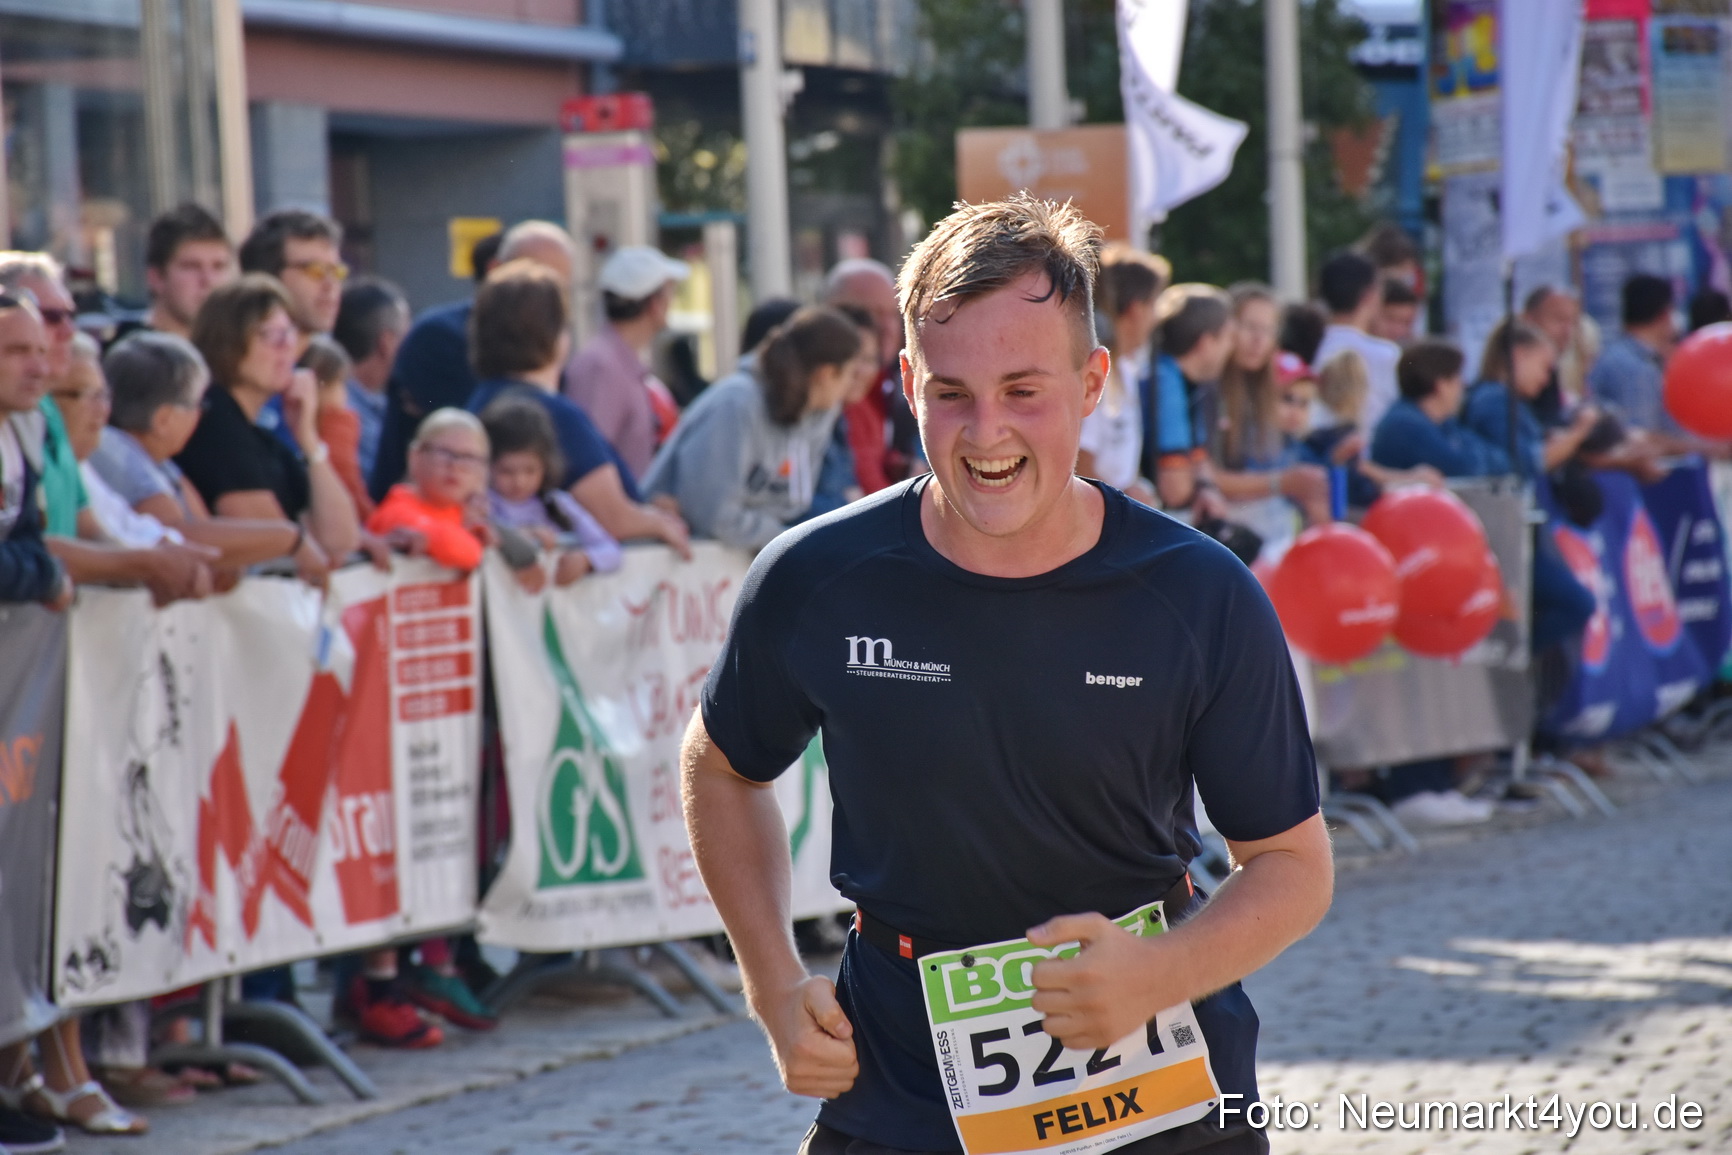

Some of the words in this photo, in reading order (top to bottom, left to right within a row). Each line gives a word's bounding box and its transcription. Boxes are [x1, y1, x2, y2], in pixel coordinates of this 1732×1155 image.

[845, 636, 892, 666] m
[883, 658, 912, 669] MÜNCH
[913, 661, 920, 670] &
[920, 661, 951, 672] MÜNCH
[1085, 671, 1143, 688] benger
[1033, 1087, 1144, 1140] FELIX
